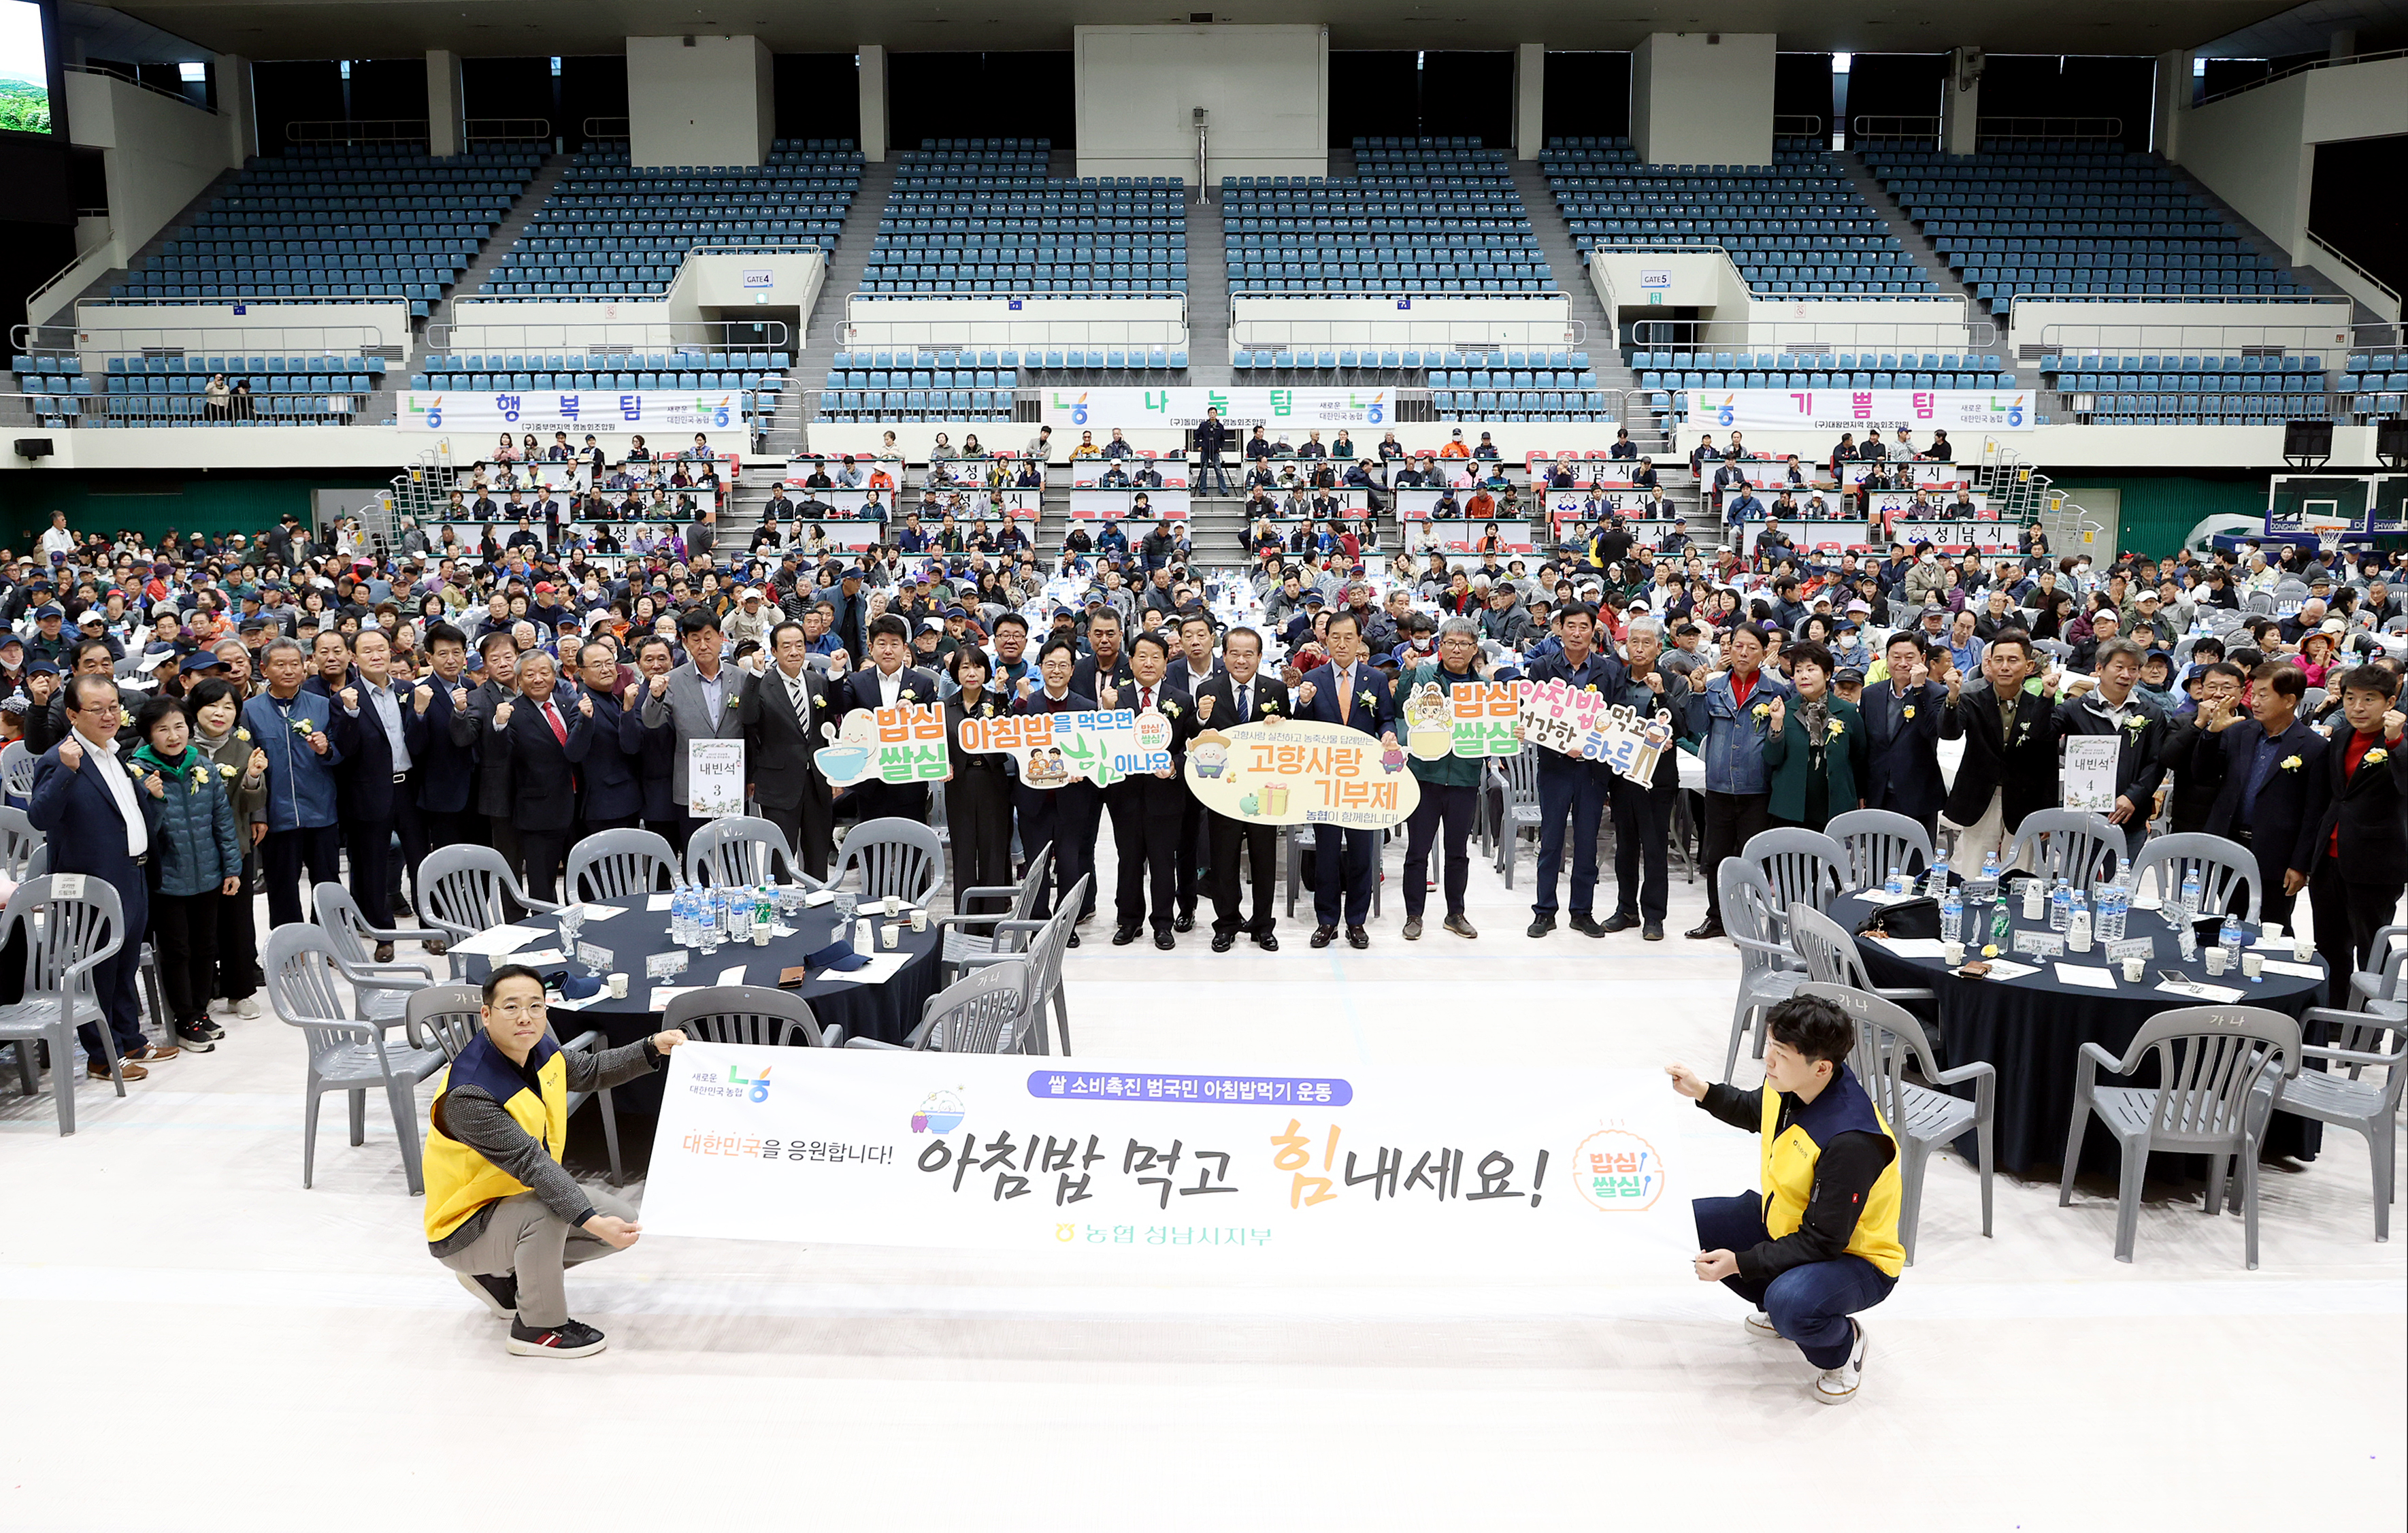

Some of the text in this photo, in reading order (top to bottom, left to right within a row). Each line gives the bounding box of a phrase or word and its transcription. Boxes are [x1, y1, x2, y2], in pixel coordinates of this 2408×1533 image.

[1453, 684, 1518, 719] 밥심
[1520, 680, 1646, 738] 아침밥 먹고
[876, 705, 944, 742] 밥심
[962, 711, 1133, 749] 아침밥을 먹으면
[1232, 730, 1374, 746] 고향사랑 실천하고 농축산물 답례받는
[1452, 722, 1518, 756] 쌀심
[879, 744, 948, 781] 쌀심
[1247, 744, 1363, 777] 고향사랑
[1583, 731, 1634, 772] 하루
[2075, 758, 2109, 771] 내빈석
[700, 763, 735, 775] 내빈석
[714, 785, 721, 796] 3
[1315, 779, 1398, 810] 기부제
[2086, 780, 2094, 791] 4
[1306, 810, 1398, 825] 농협이 함께합니다!
[689, 1085, 743, 1098] 대한민국 농협
[692, 1072, 716, 1083] 새로운
[1047, 1075, 1332, 1102] 쌀 소비촉진 범국민 아침밥먹기 운동
[682, 1131, 893, 1165] 대한민국을 응원합니다!
[918, 1132, 1104, 1207] 아침밥
[1124, 1138, 1238, 1210] 먹고
[1086, 1224, 1272, 1247] 농협 성남시지부
